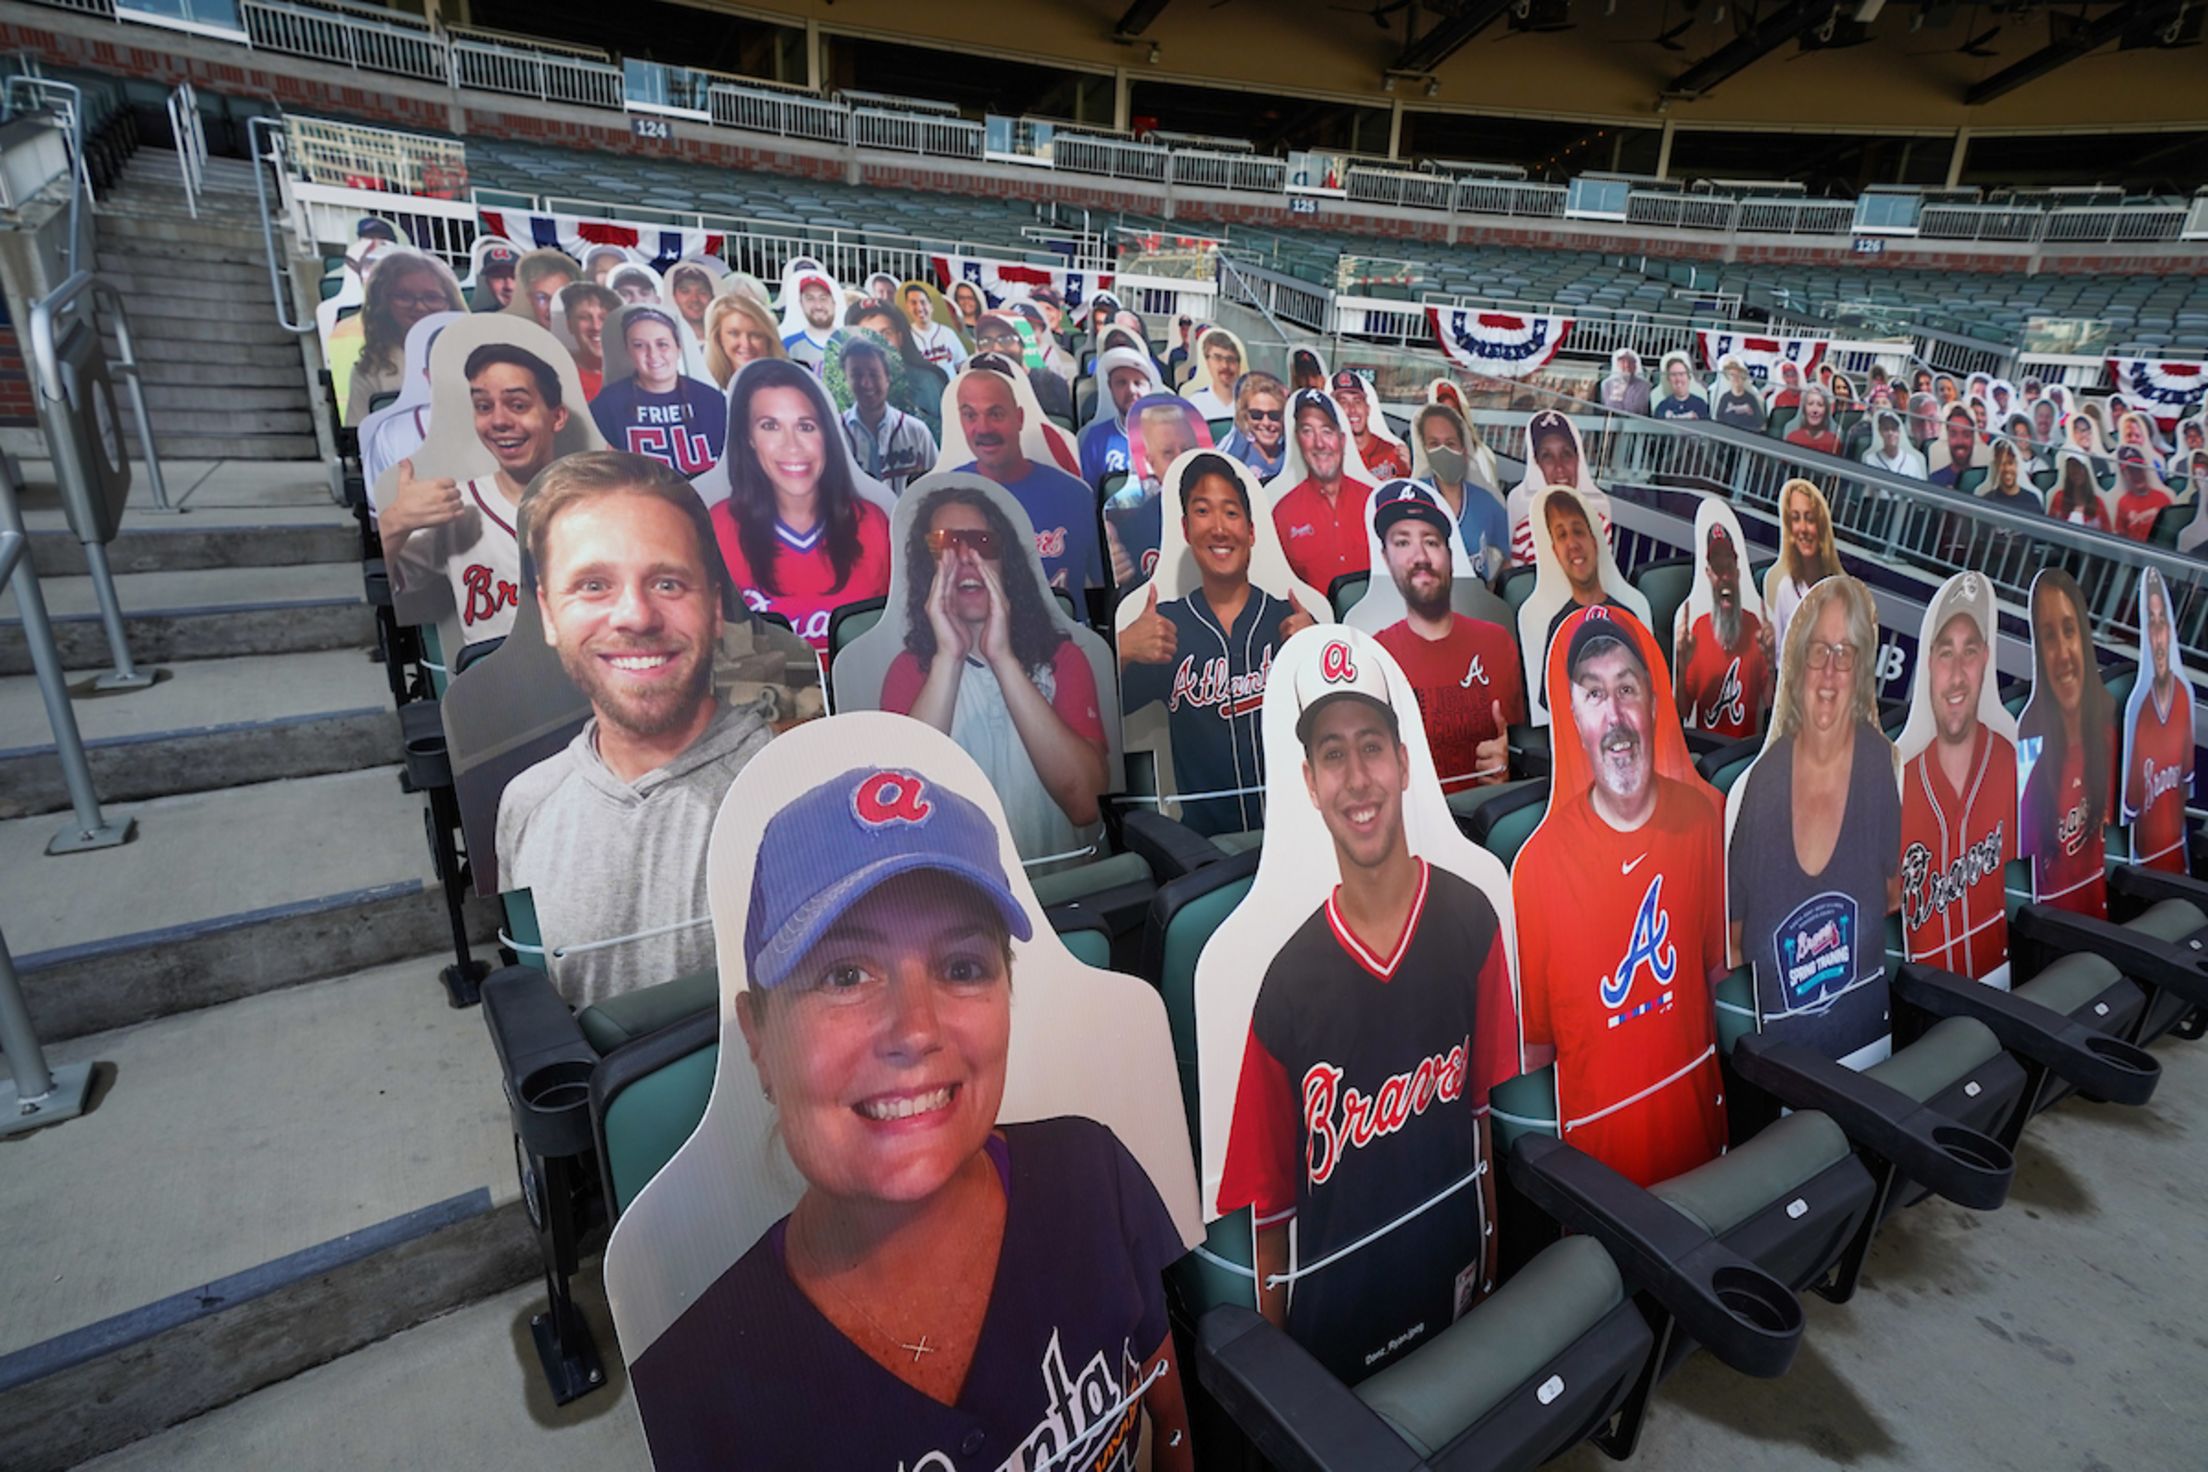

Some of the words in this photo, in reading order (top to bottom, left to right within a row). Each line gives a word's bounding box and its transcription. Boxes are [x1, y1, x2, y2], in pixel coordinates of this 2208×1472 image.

[637, 120, 667, 138] 124
[1293, 200, 1316, 214] 125
[1858, 240, 1881, 252] 126
[1398, 485, 1416, 500] A
[1169, 643, 1273, 713] Atlant
[1322, 640, 1358, 684] a
[1460, 654, 1490, 688] A
[1704, 656, 1745, 729] A
[853, 769, 932, 826] a
[1600, 873, 1677, 1009] A
